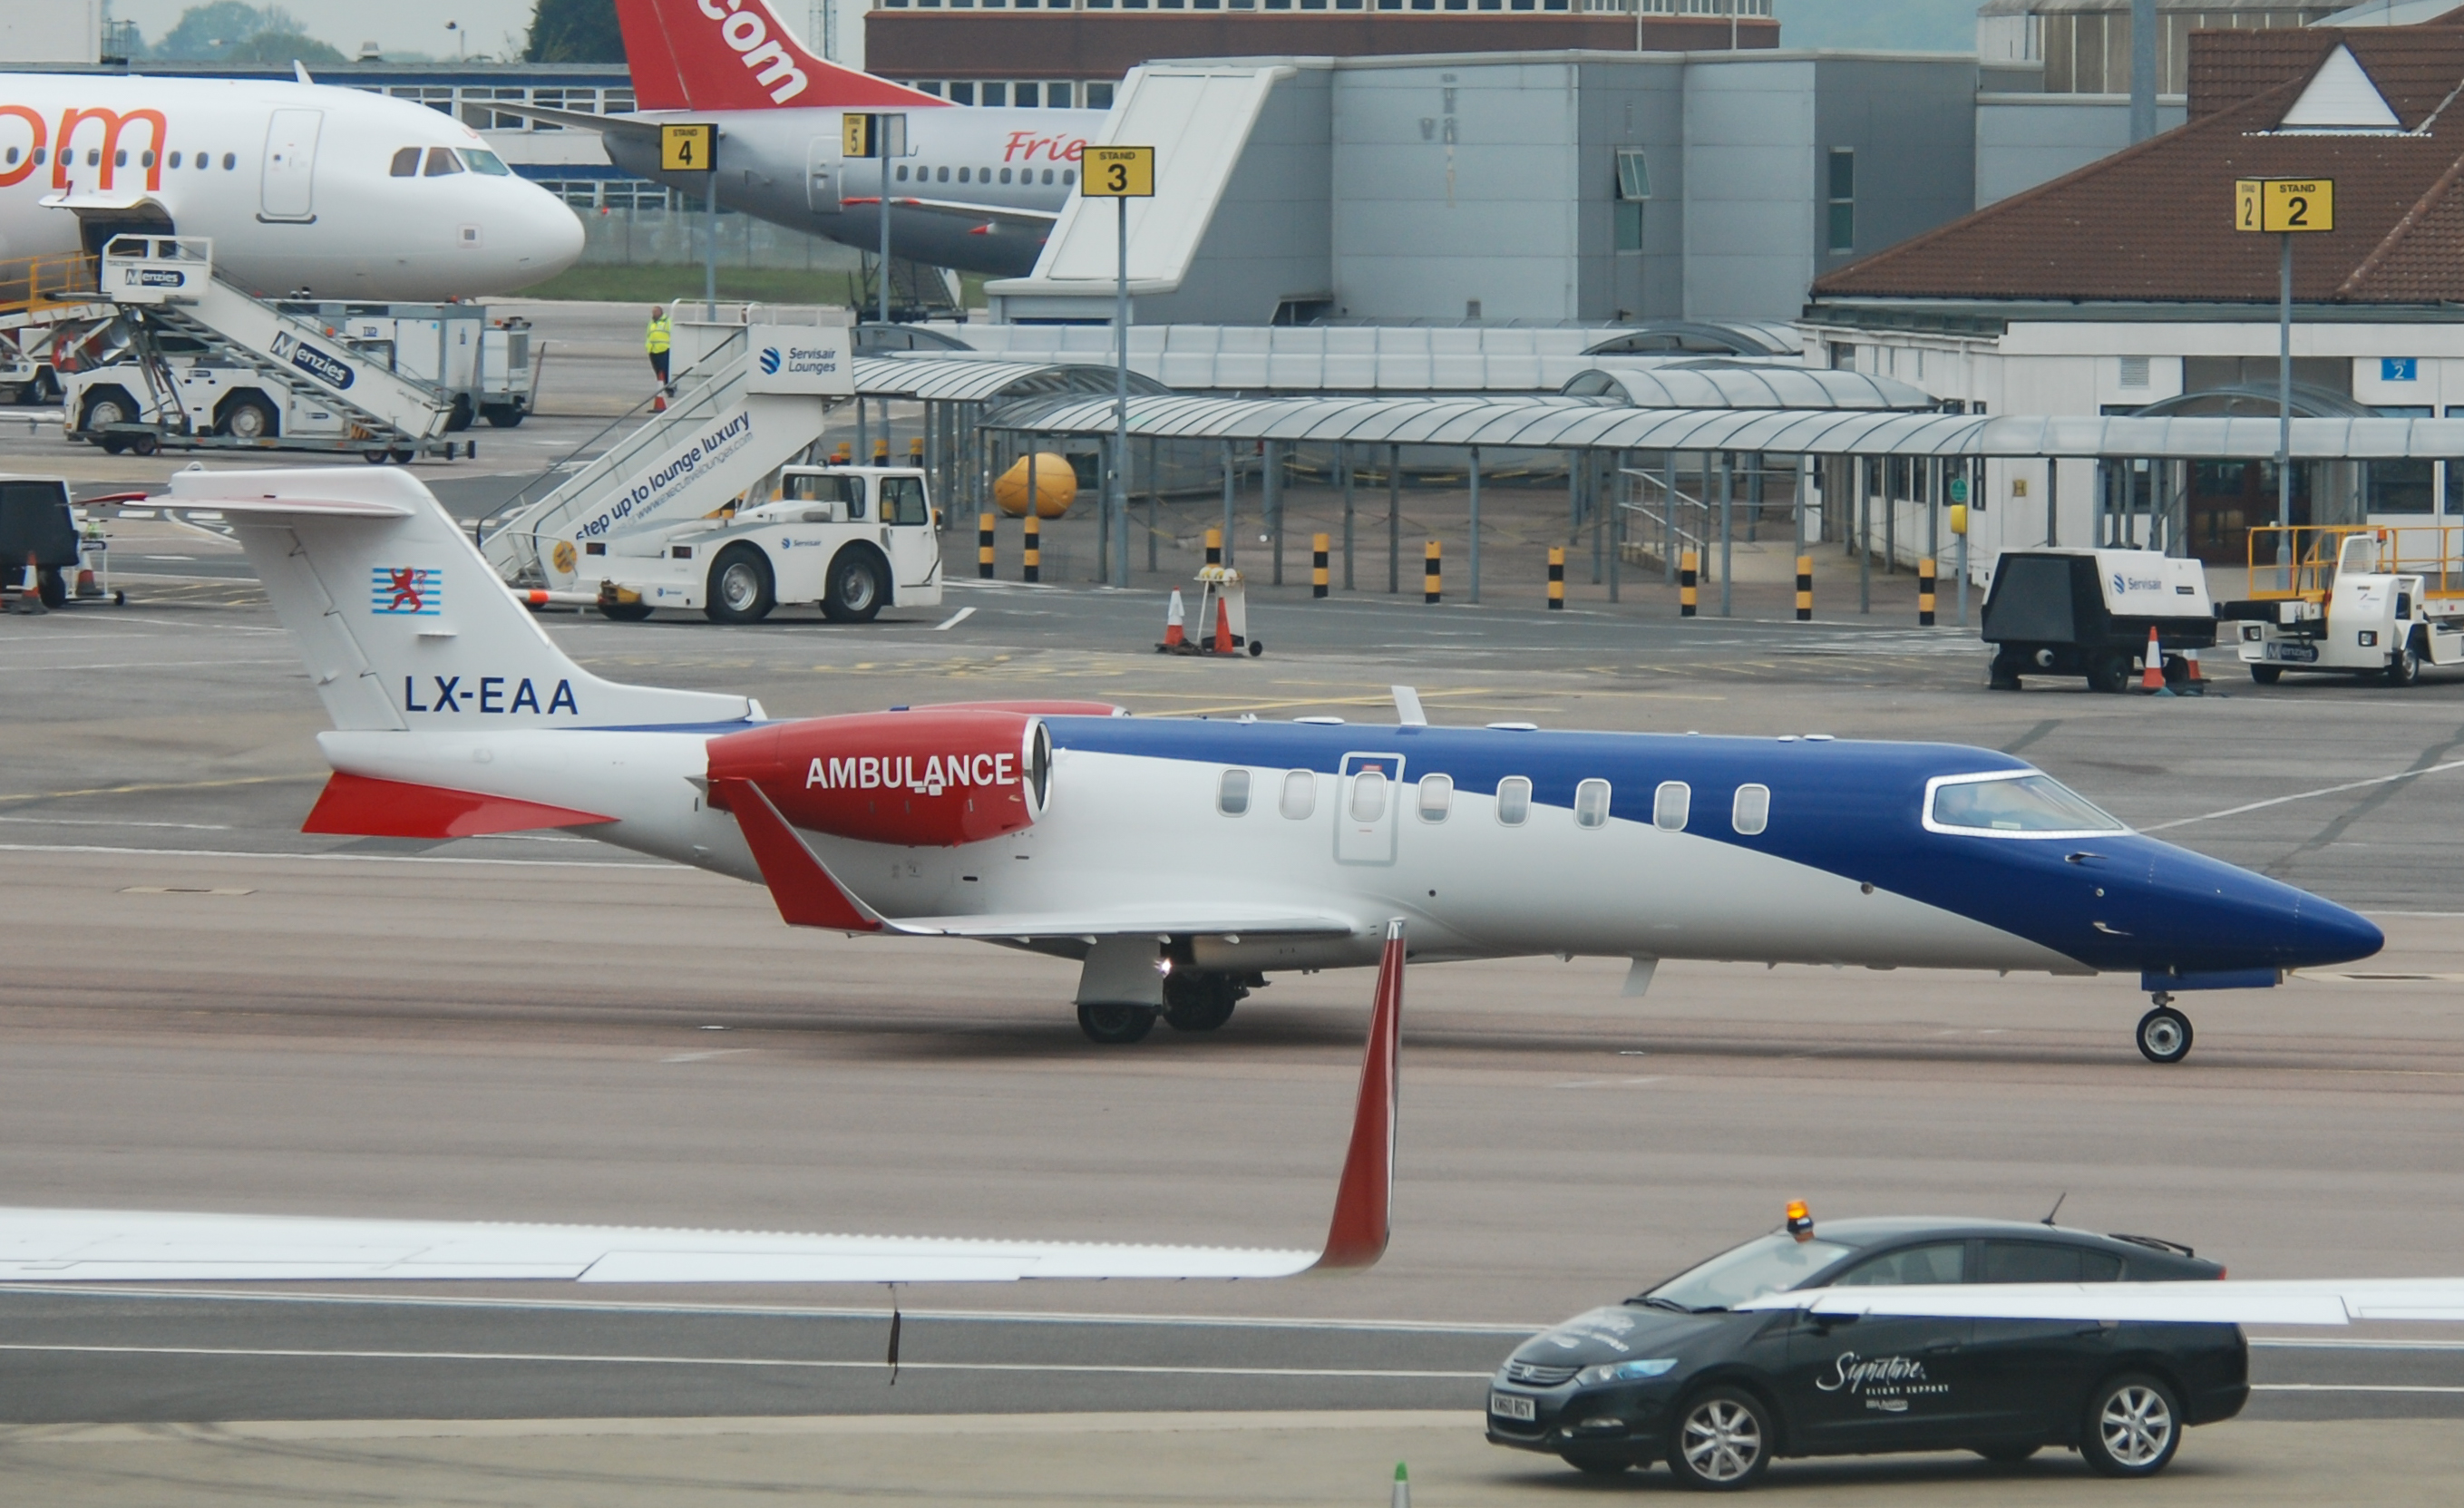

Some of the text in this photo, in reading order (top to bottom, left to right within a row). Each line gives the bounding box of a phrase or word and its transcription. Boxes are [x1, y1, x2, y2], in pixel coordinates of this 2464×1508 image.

[673, 129, 697, 137] STAND
[851, 128, 858, 152] 5
[678, 141, 693, 166] 4
[1099, 151, 1135, 161] STAND
[1107, 163, 1127, 192] 3
[2279, 184, 2317, 193] STAND
[2245, 197, 2253, 226] 2
[2288, 196, 2308, 226] 2
[126, 270, 178, 285] Menzies
[271, 334, 346, 382] Menzies
[788, 347, 836, 359] Servisair
[788, 361, 836, 375] Lounges
[2394, 365, 2404, 379] 2
[611, 498, 632, 520] up
[631, 485, 649, 504] to
[648, 447, 702, 491] lounge
[701, 411, 750, 453] luxury
[2128, 577, 2162, 590] Servisair
[2267, 644, 2313, 661] Menzies
[405, 676, 579, 715] LX-EAA
[805, 753, 1015, 789] AMBULANCE
[1816, 1350, 1924, 1395] Signature
[1866, 1384, 1949, 1396] FLIGHT SUPPORT
